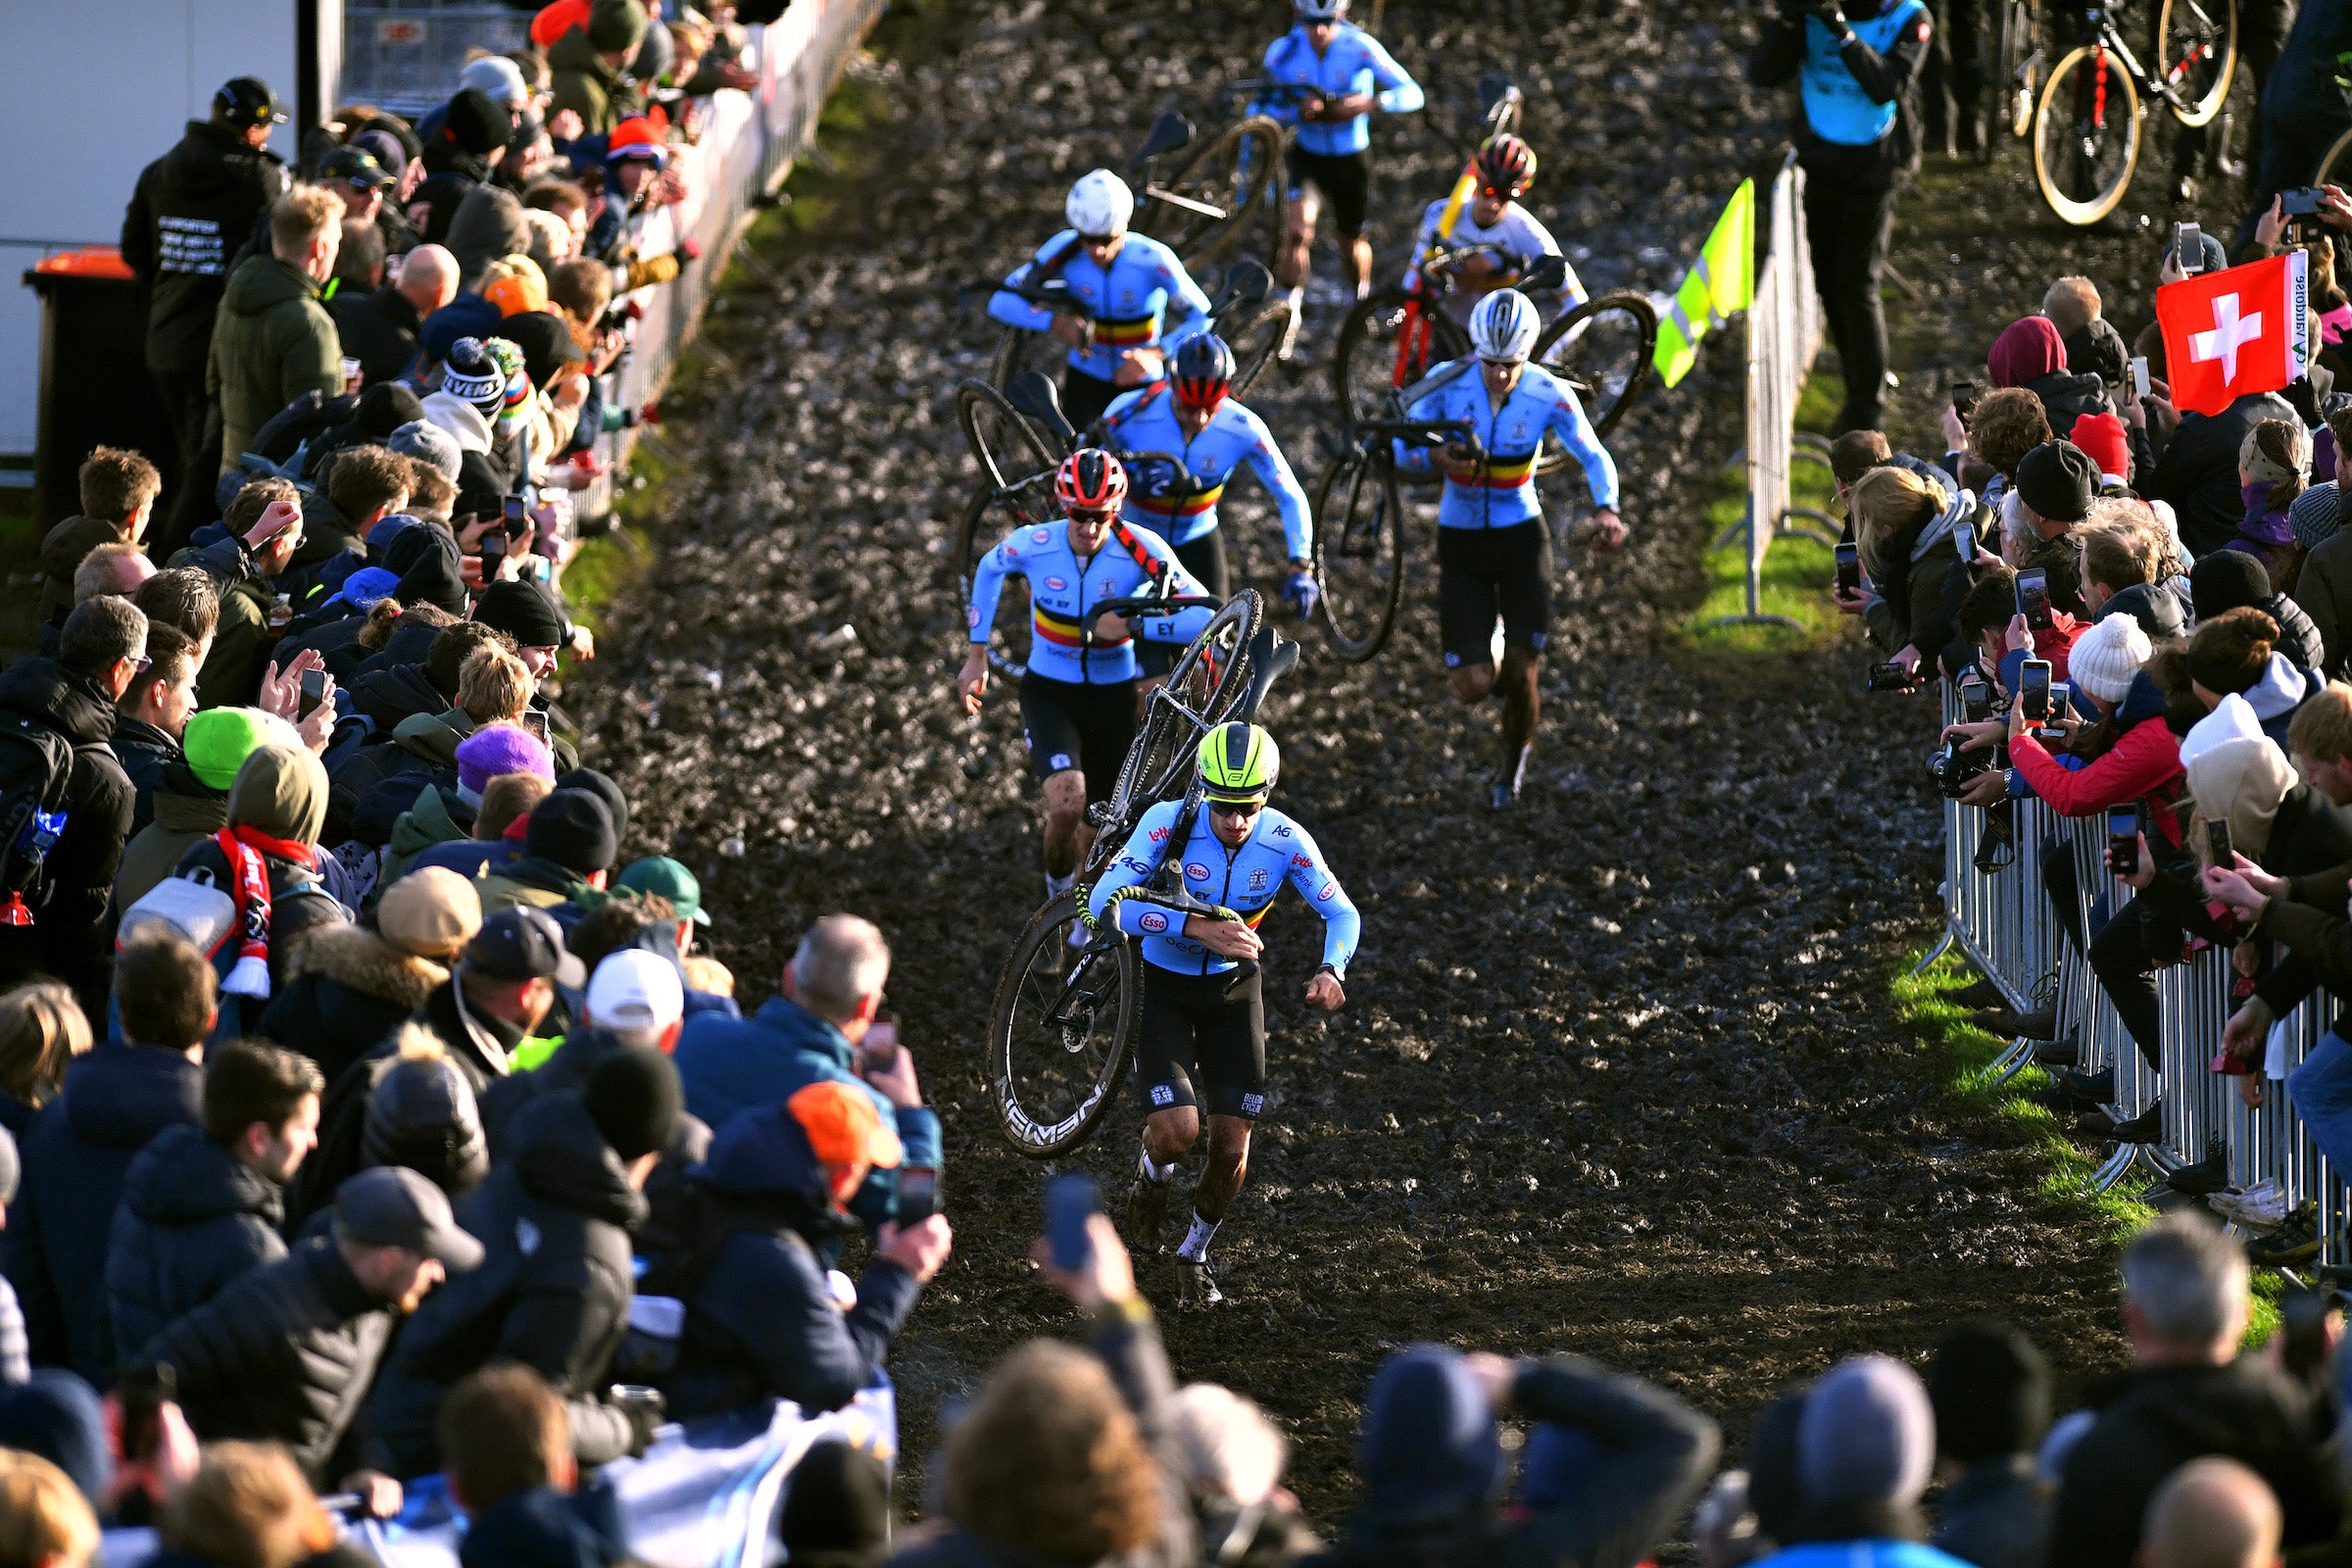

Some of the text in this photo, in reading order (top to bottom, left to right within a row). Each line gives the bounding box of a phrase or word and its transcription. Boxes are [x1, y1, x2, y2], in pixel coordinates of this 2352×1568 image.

[1157, 622, 1175, 635] EY
[1271, 825, 1292, 838] AG
[1194, 891, 1211, 901] EY
[1143, 915, 1165, 928] Esso
